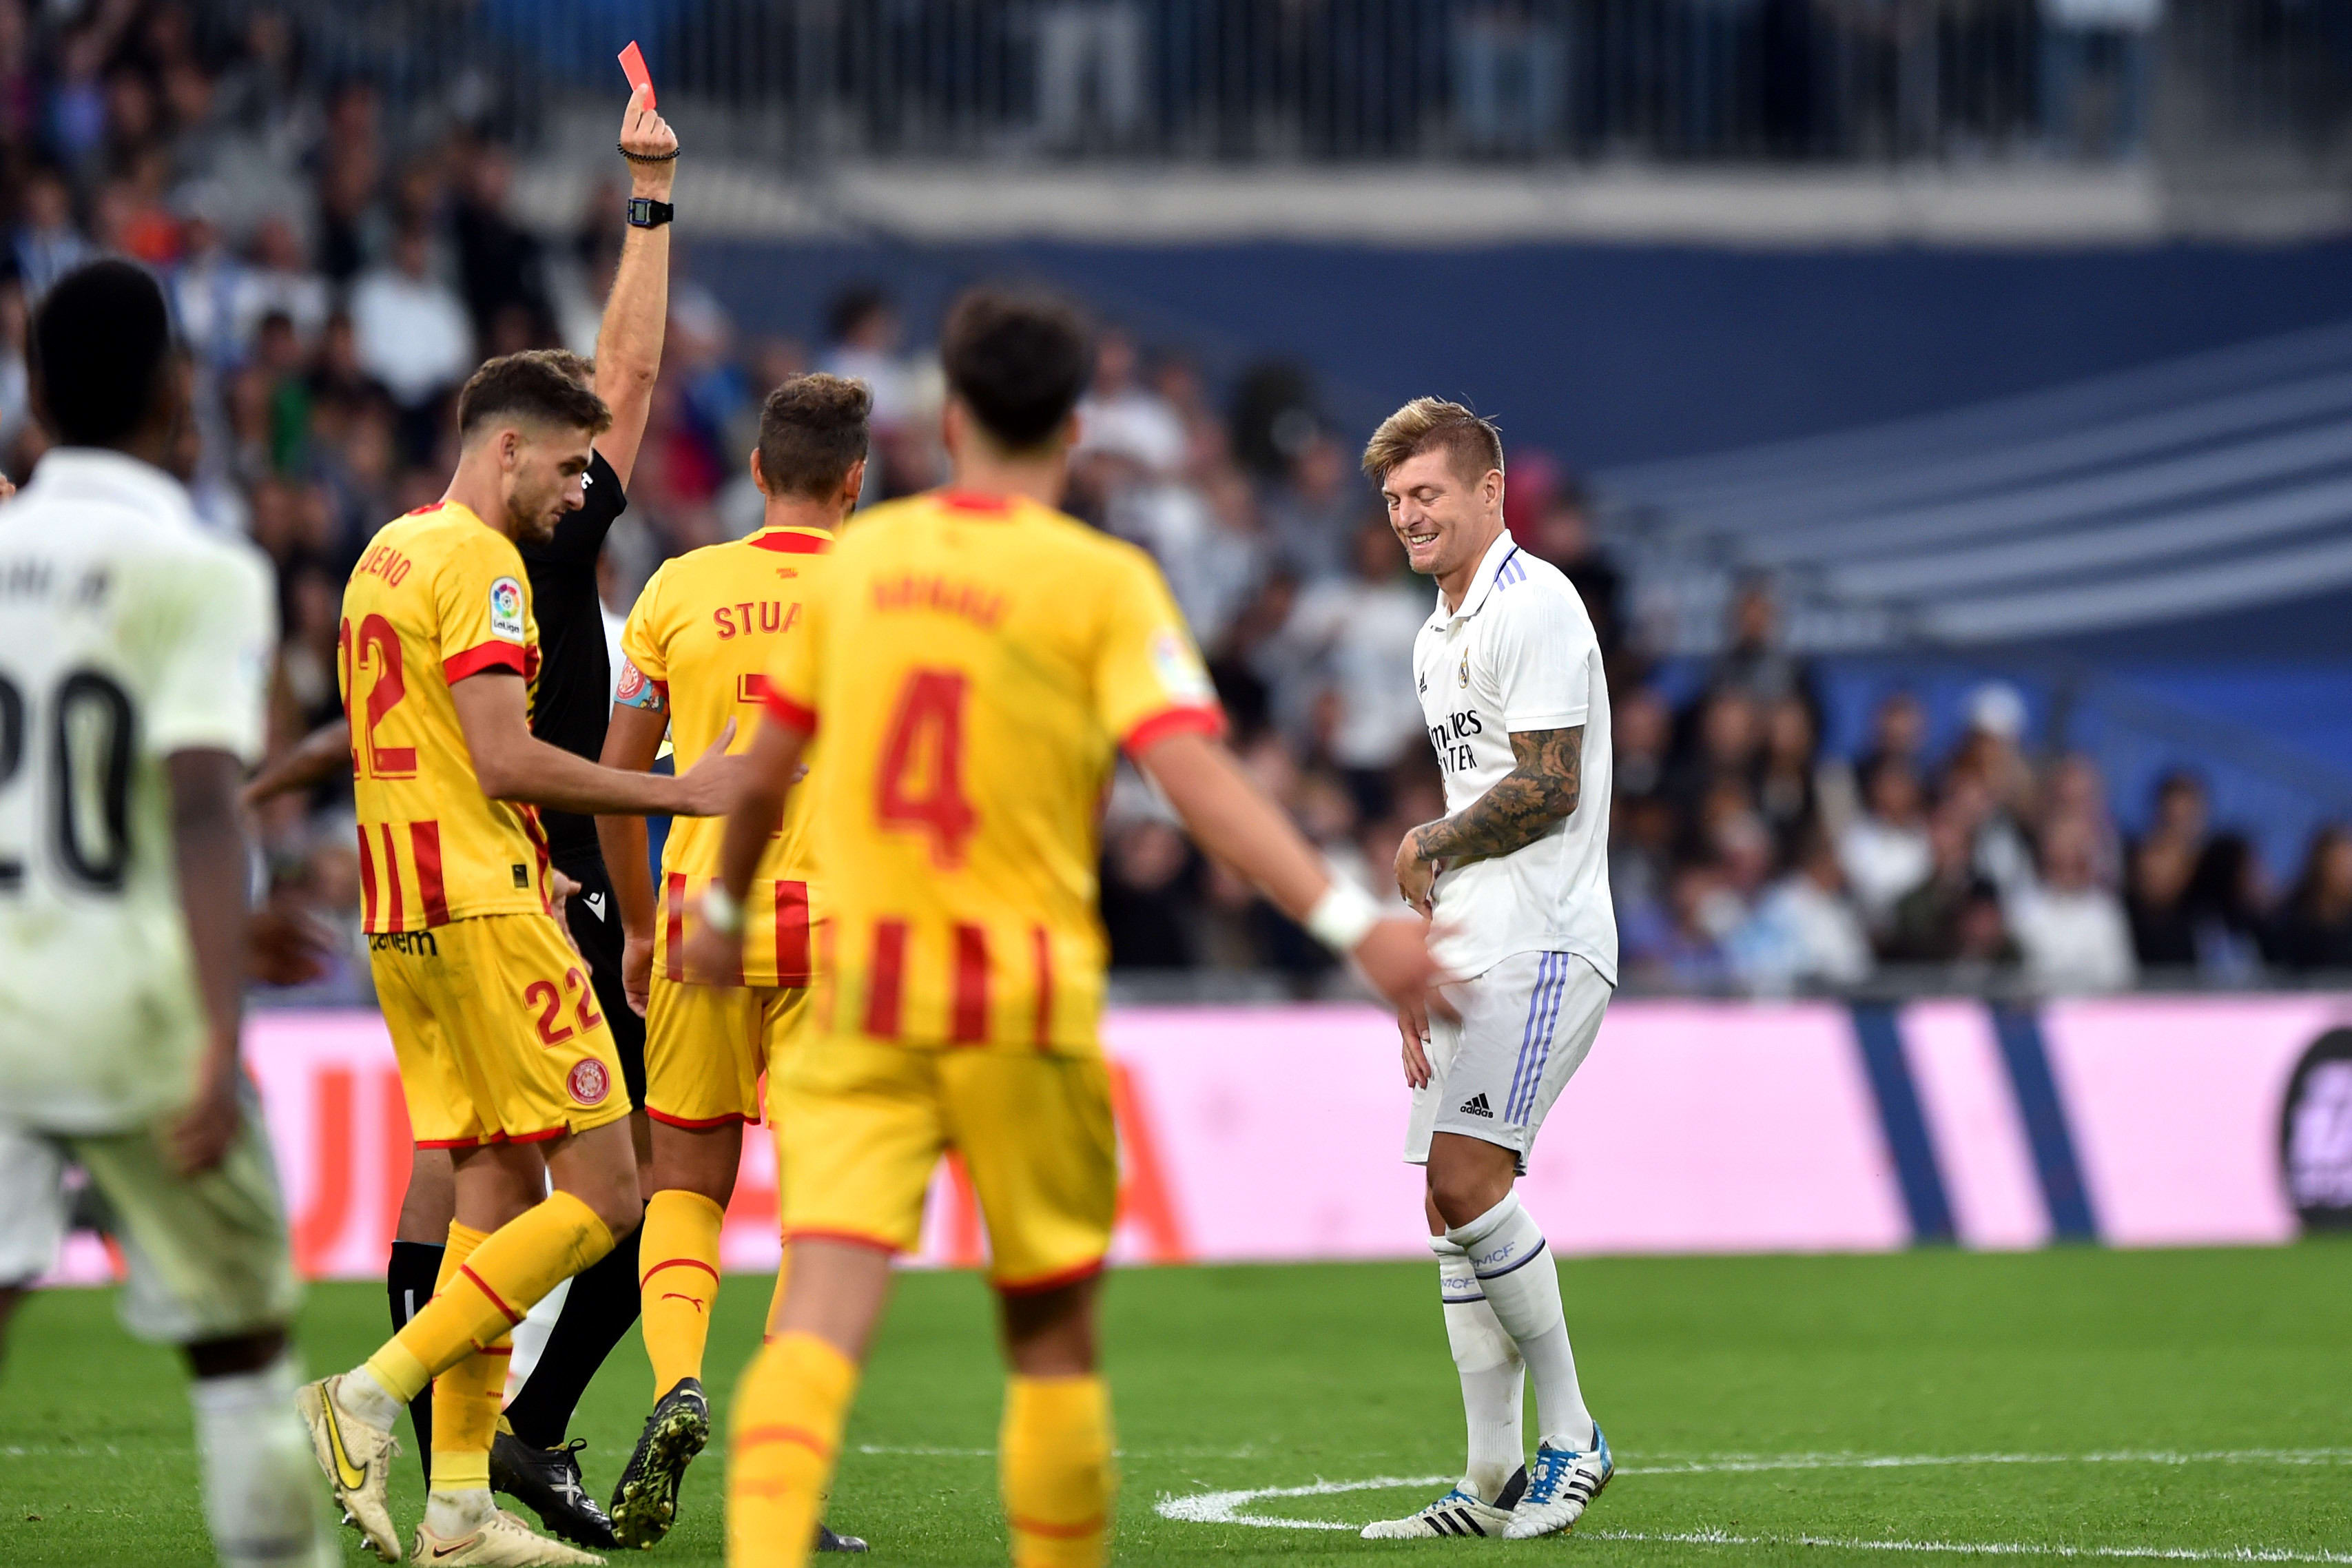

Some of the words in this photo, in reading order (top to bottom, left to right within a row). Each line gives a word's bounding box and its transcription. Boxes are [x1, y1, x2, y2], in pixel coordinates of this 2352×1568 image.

[348, 544, 411, 588] UENO
[874, 663, 982, 871] 4
[522, 967, 604, 1050] 22
[1460, 1106, 1494, 1119] adidas
[1469, 1241, 1515, 1267] MCF
